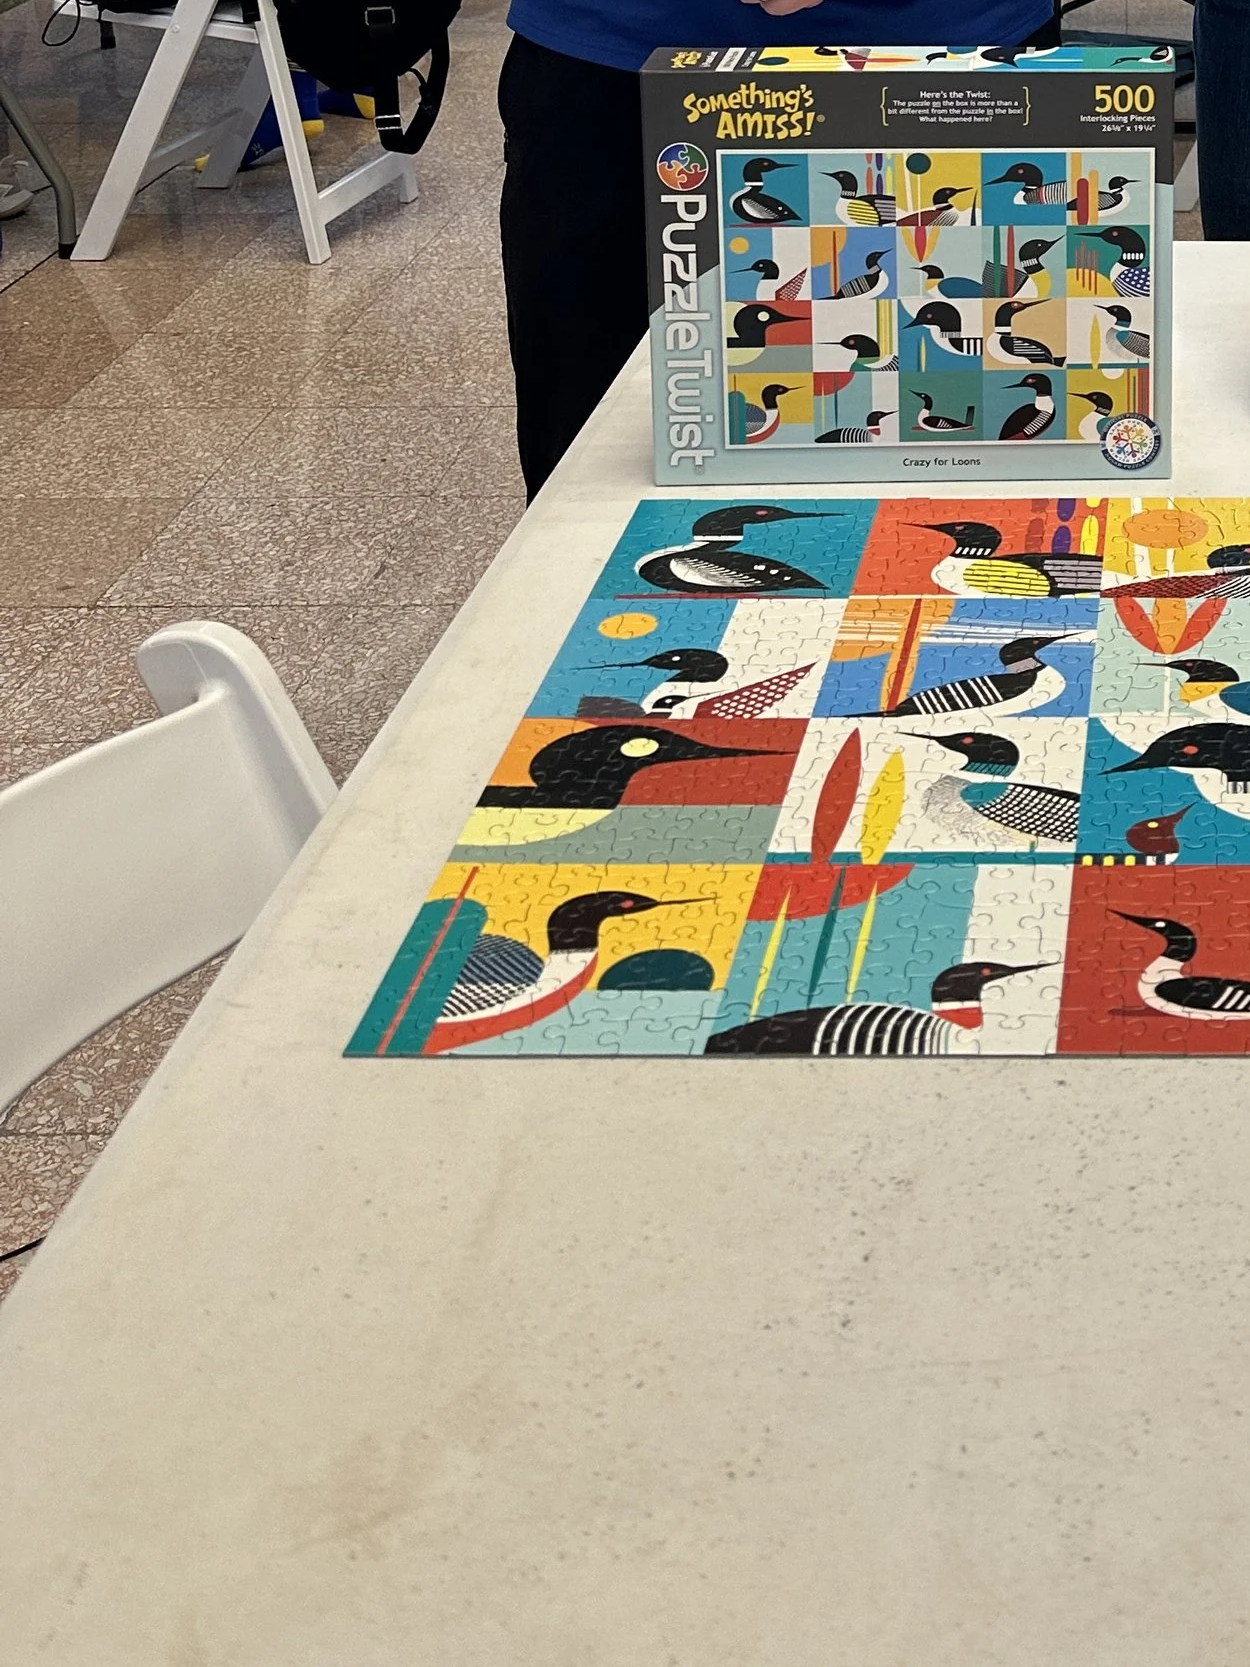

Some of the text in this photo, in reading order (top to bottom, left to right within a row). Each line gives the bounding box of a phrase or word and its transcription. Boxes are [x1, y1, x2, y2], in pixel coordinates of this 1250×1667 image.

[683, 82, 815, 123] Something's
[919, 90, 991, 99] Here's the Twist:
[1094, 84, 1155, 113] 500
[1080, 115, 1128, 124] Interlocking
[660, 194, 716, 466] PuzzleTwist
[902, 457, 981, 468] Crazy for Loons
